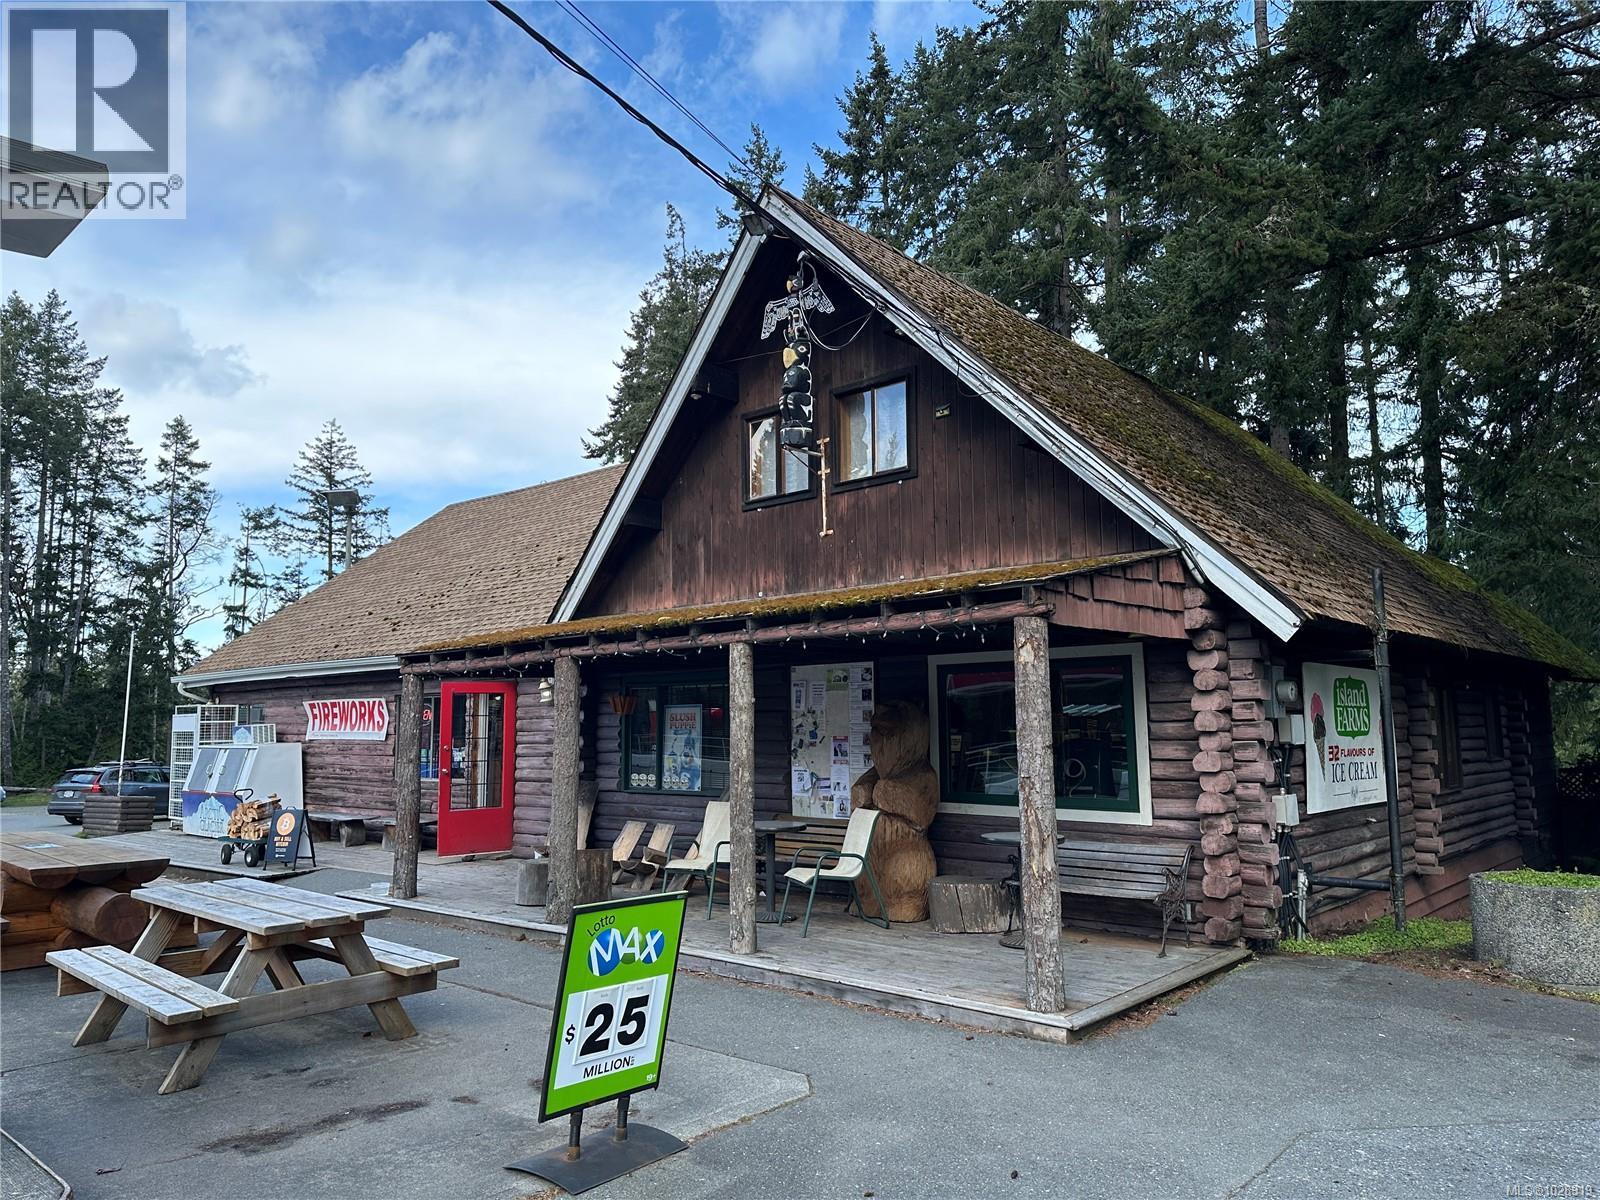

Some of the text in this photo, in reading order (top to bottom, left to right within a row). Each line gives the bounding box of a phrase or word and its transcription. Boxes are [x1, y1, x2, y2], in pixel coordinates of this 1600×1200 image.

[1336, 680, 1367, 707] island
[308, 700, 385, 732] FIREWORKS
[669, 712, 697, 722] SLUSH
[1336, 707, 1370, 732] FARMS
[1328, 743, 1375, 762] 32 FLAVOURS OF
[1331, 761, 1378, 783] ICE CREAM
[586, 914, 616, 938] Lotto
[589, 926, 664, 977] MAX
[564, 994, 650, 1057] $ 25
[583, 1055, 632, 1079] MILLION
